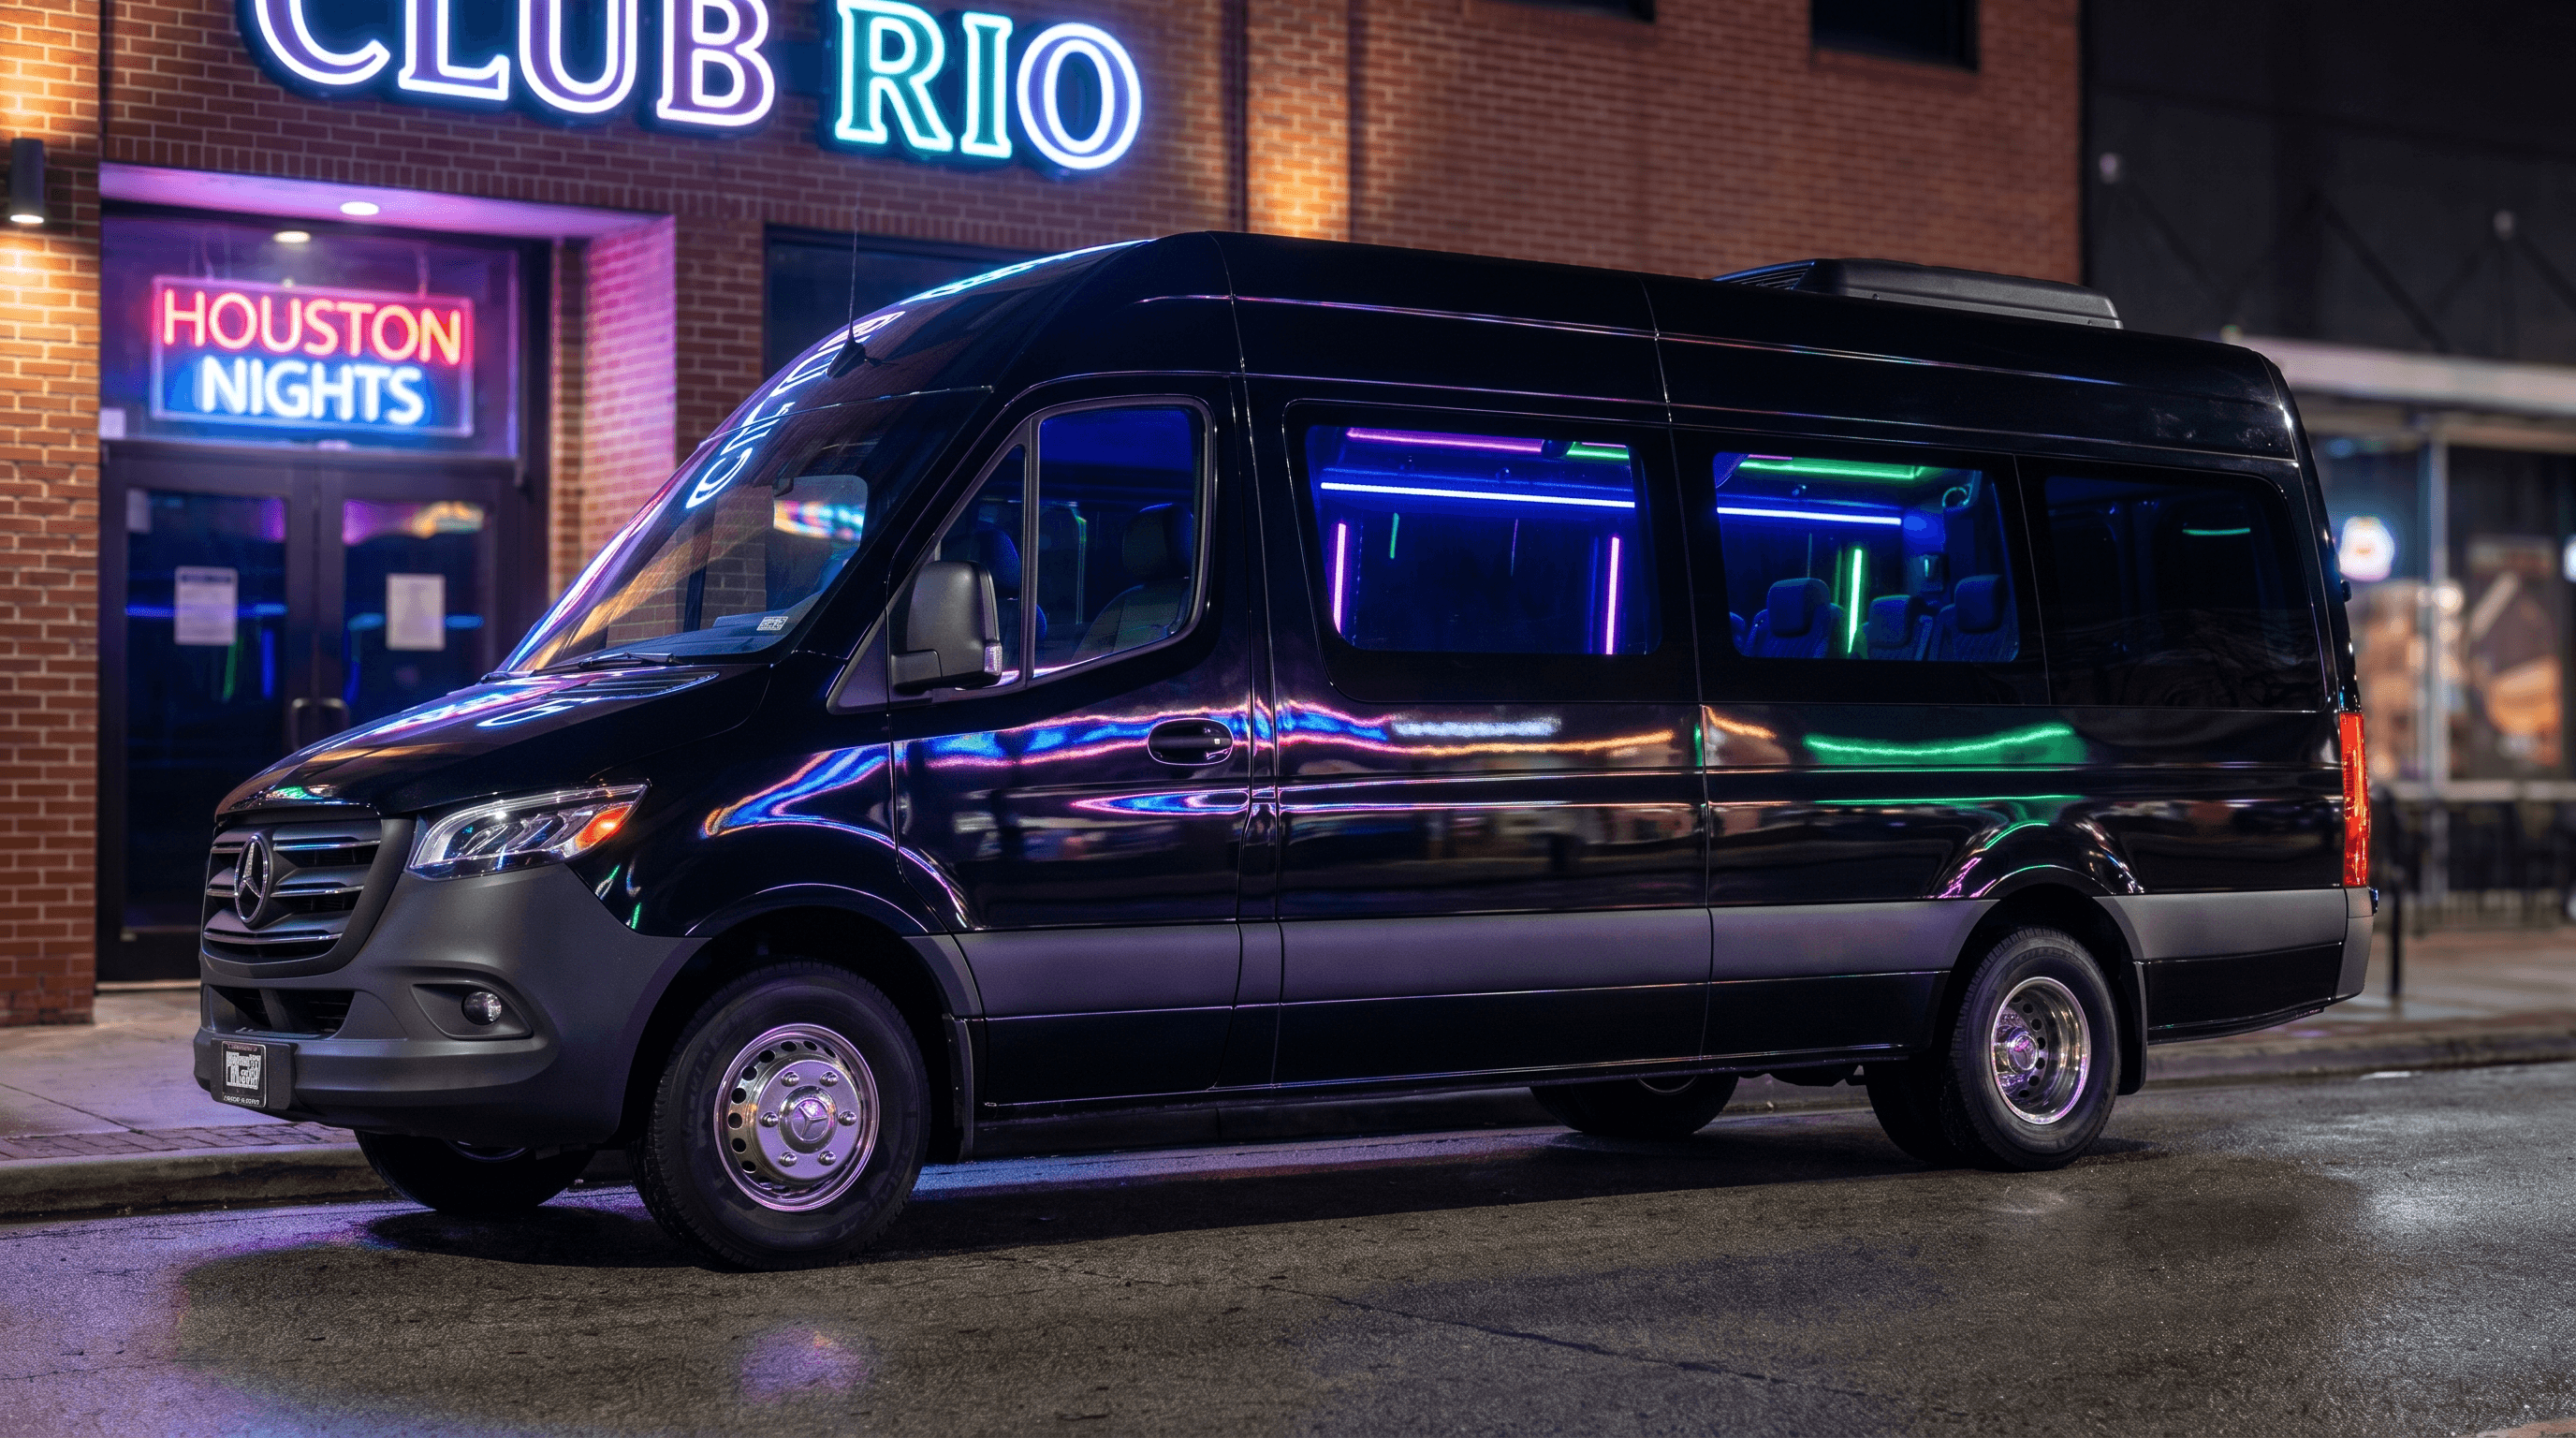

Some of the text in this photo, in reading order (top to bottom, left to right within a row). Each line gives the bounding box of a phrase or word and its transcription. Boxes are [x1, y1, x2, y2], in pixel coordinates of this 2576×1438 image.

[254, 0, 1142, 171] CLUB RIO
[162, 288, 461, 365] HOUSTON
[198, 355, 426, 427] NIGHTS
